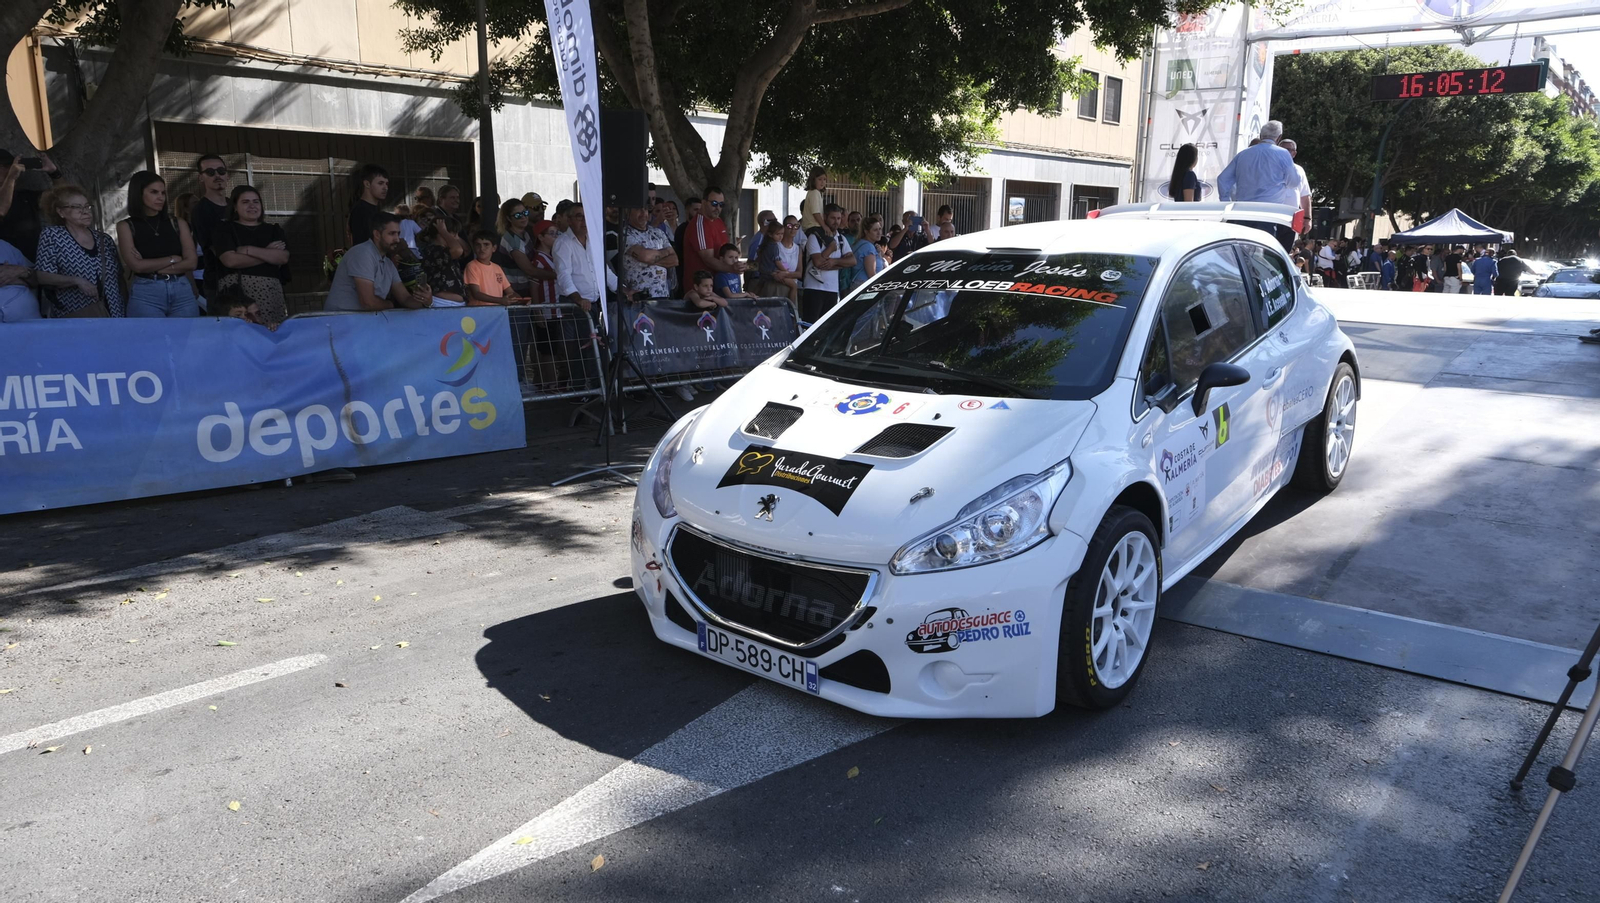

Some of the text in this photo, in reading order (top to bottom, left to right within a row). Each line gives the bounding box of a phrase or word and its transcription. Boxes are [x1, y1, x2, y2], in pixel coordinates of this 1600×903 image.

[1399, 69, 1506, 98] 16:05:12
[1159, 142, 1218, 151] CURA
[926, 260, 967, 272] Mi
[1014, 260, 1088, 278] Jesús
[893, 402, 910, 414] 6
[197, 385, 497, 467] deportes
[1218, 405, 1228, 445] 6
[1169, 454, 1198, 481] ALMERÍA
[693, 559, 836, 629] Adorna
[957, 621, 1032, 644] PEDRO RUIZ
[808, 681, 817, 691] 32
